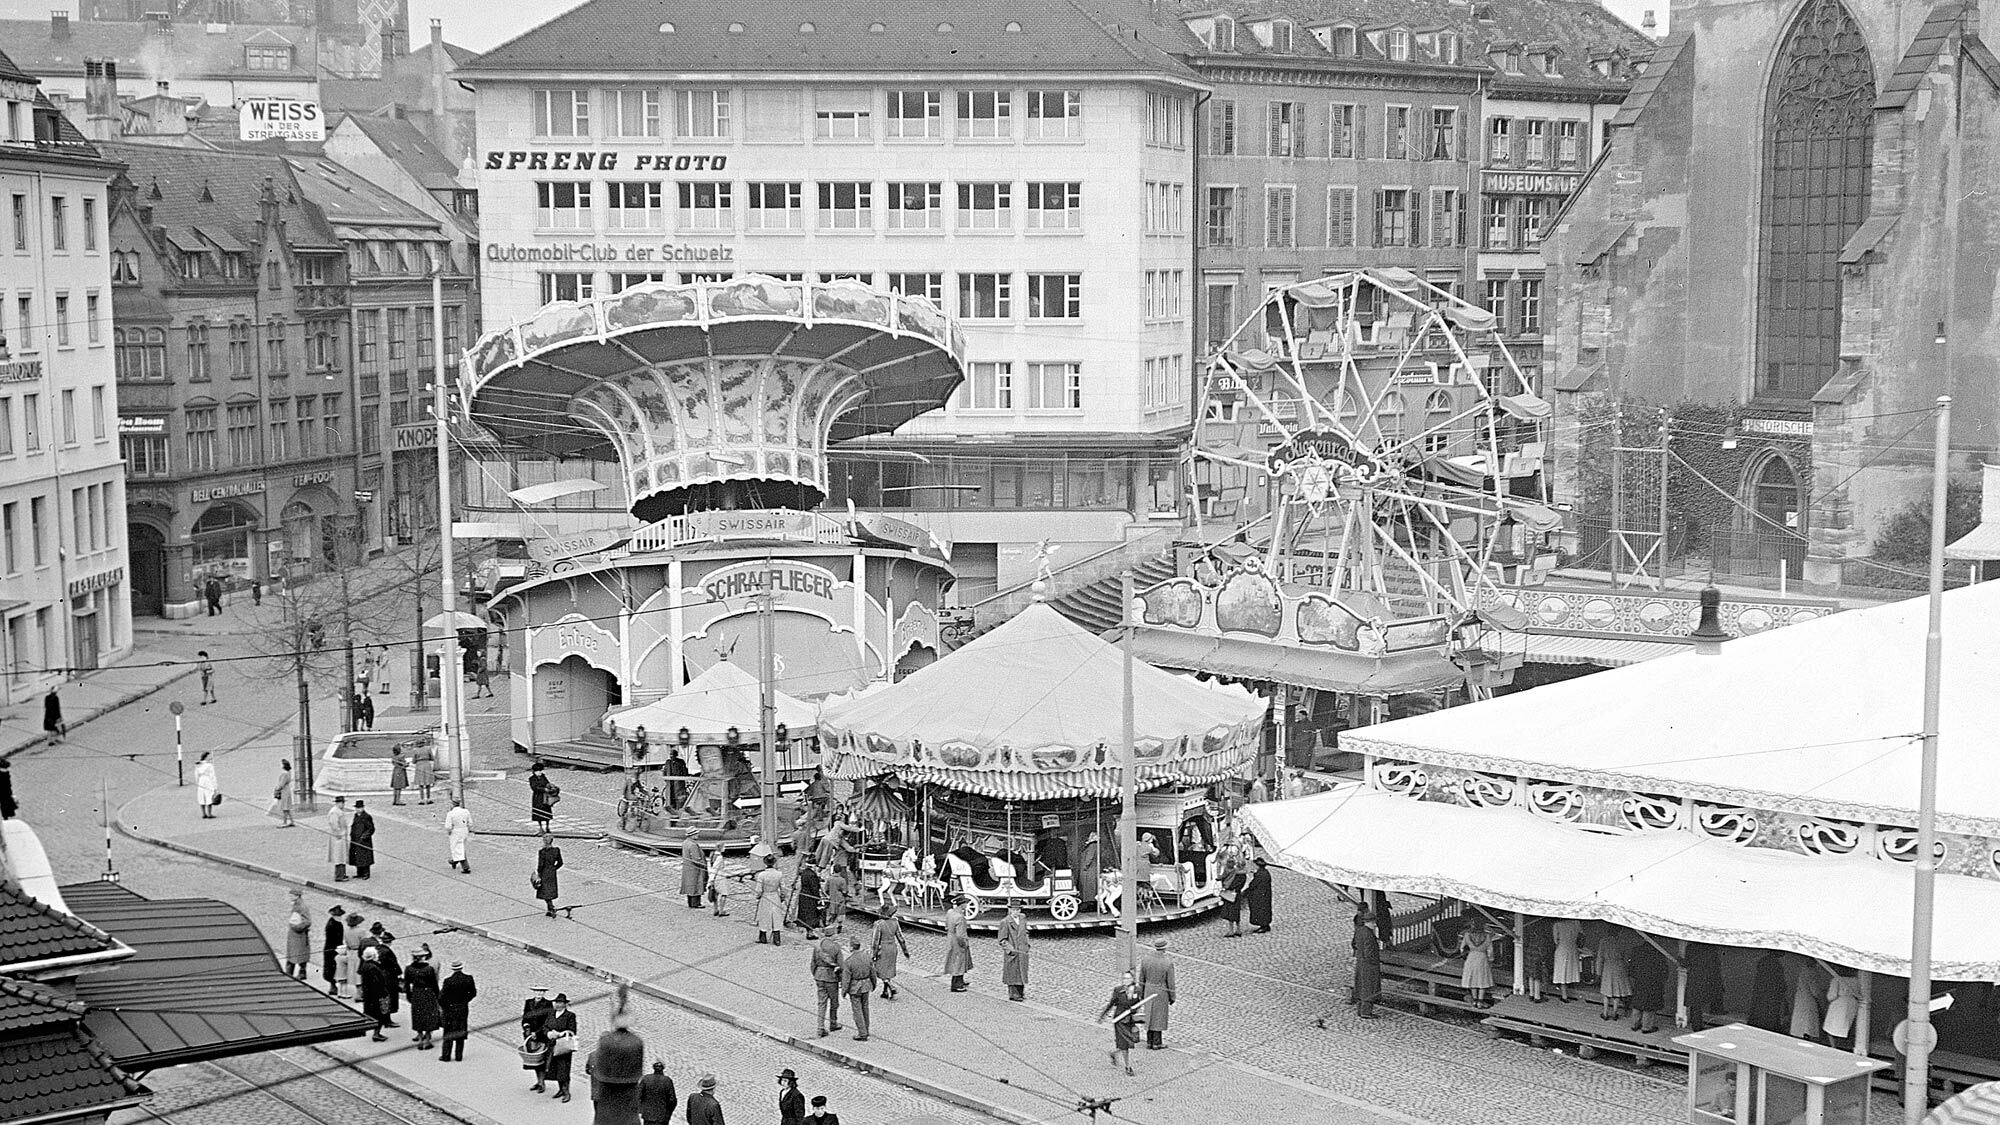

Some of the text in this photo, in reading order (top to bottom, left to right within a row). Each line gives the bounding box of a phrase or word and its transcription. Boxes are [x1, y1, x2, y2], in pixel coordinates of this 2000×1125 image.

[250, 102, 316, 121] WEISS
[248, 130, 319, 139] STREITGASSE
[264, 122, 300, 130] IN DER
[484, 151, 728, 171] SPRENG PHOTO
[625, 243, 654, 261] der
[661, 242, 734, 263] Schweiz
[192, 487, 211, 503] BELL
[719, 519, 786, 530] SWISSAIR
[882, 522, 921, 541] SWISSAIR
[543, 537, 596, 557] SWISSAIR
